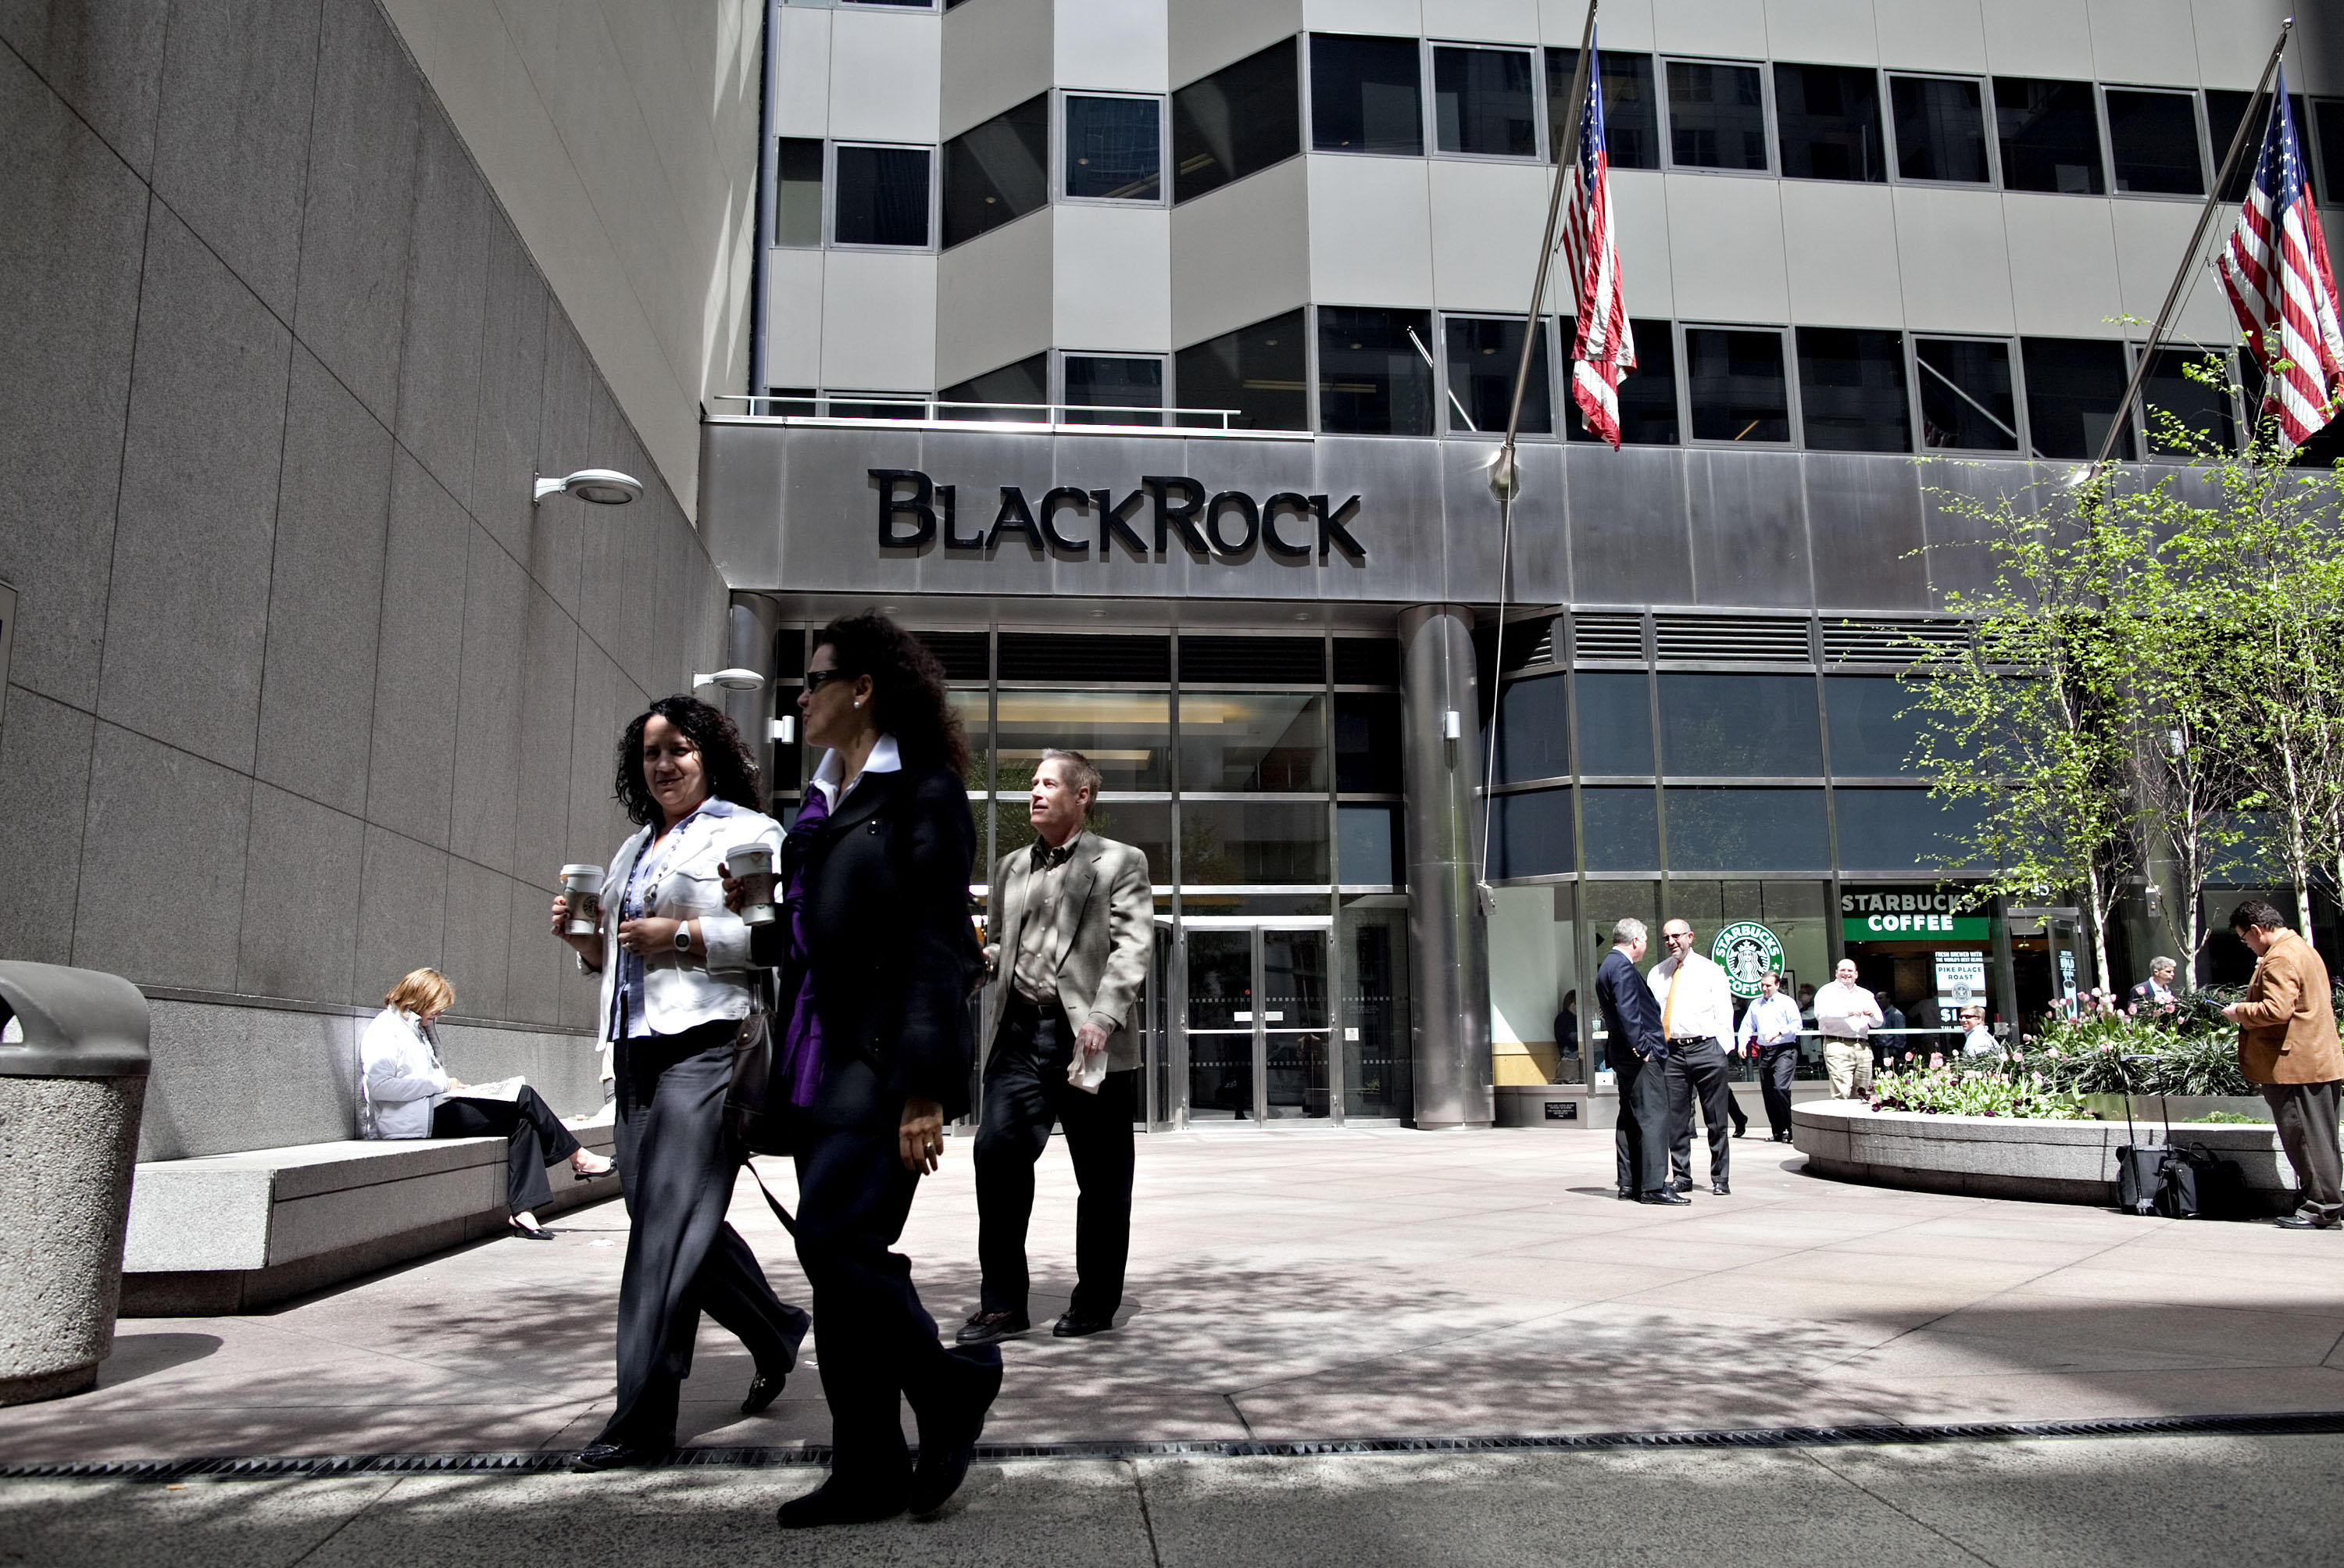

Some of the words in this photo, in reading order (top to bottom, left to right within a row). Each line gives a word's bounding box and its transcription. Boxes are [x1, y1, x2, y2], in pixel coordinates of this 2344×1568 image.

[867, 469, 1367, 555] BLACKROCK
[1842, 895, 1977, 911] STARBUCKS
[1868, 914, 1954, 931] COFFEE
[1715, 925, 1780, 958] STARBUCKS
[1727, 975, 1763, 995] COFF
